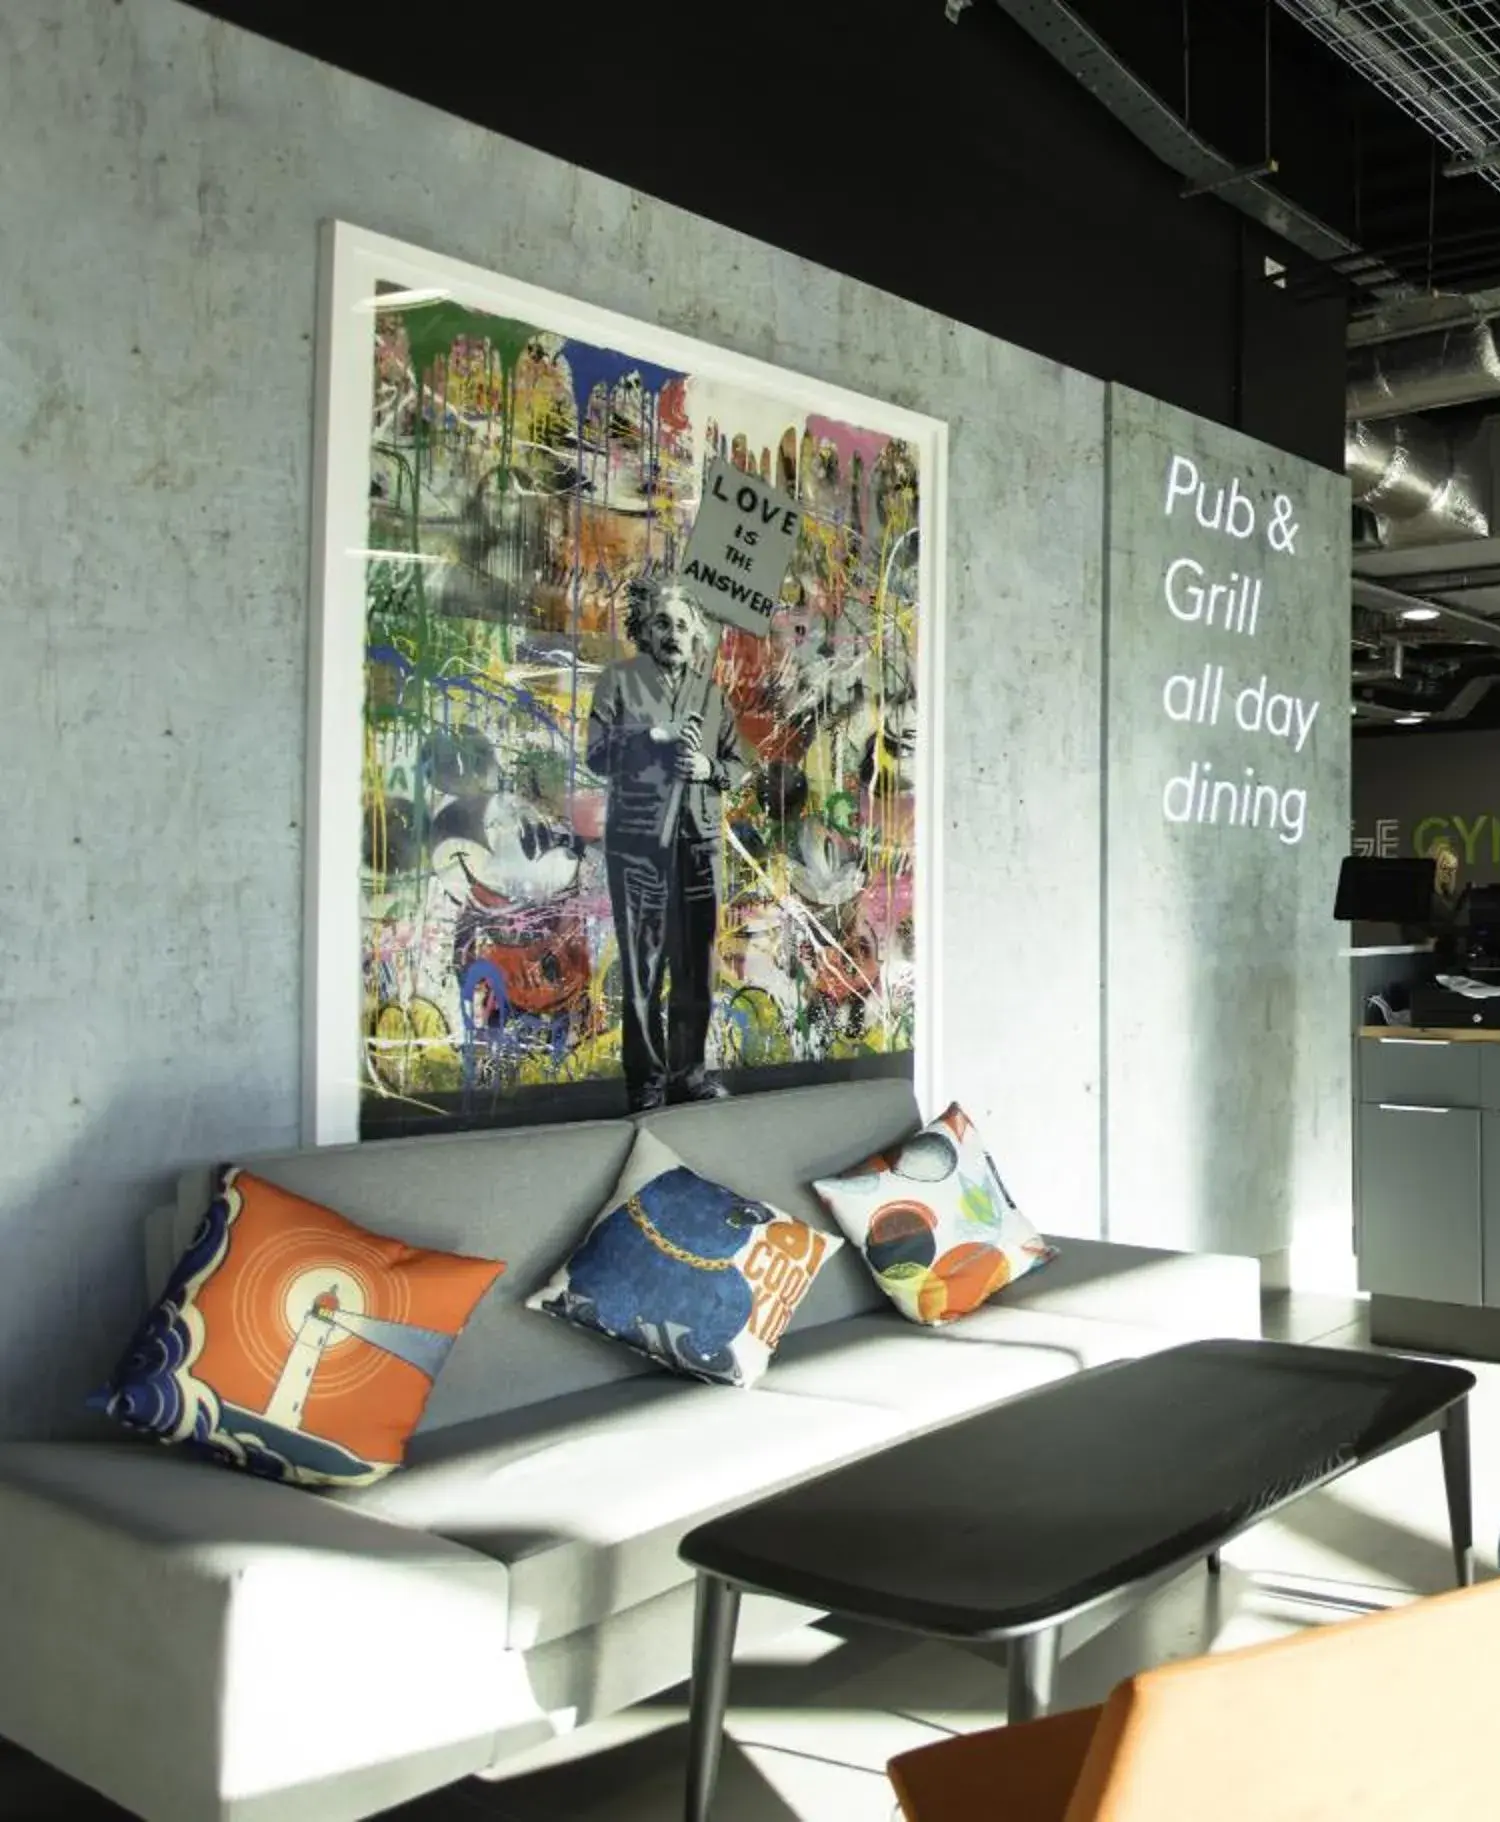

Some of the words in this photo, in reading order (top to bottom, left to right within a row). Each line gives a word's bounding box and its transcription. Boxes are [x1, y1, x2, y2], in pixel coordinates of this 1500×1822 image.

[711, 475, 798, 536] LOVE
[734, 524, 760, 546] IS
[1164, 454, 1255, 539] Pub
[1267, 493, 1300, 555] &
[683, 559, 774, 617] ANSWER
[725, 544, 754, 573] THE
[1164, 558, 1263, 636] Grill
[1163, 663, 1223, 725] all
[1235, 675, 1320, 752] day
[1162, 761, 1307, 845] dining
